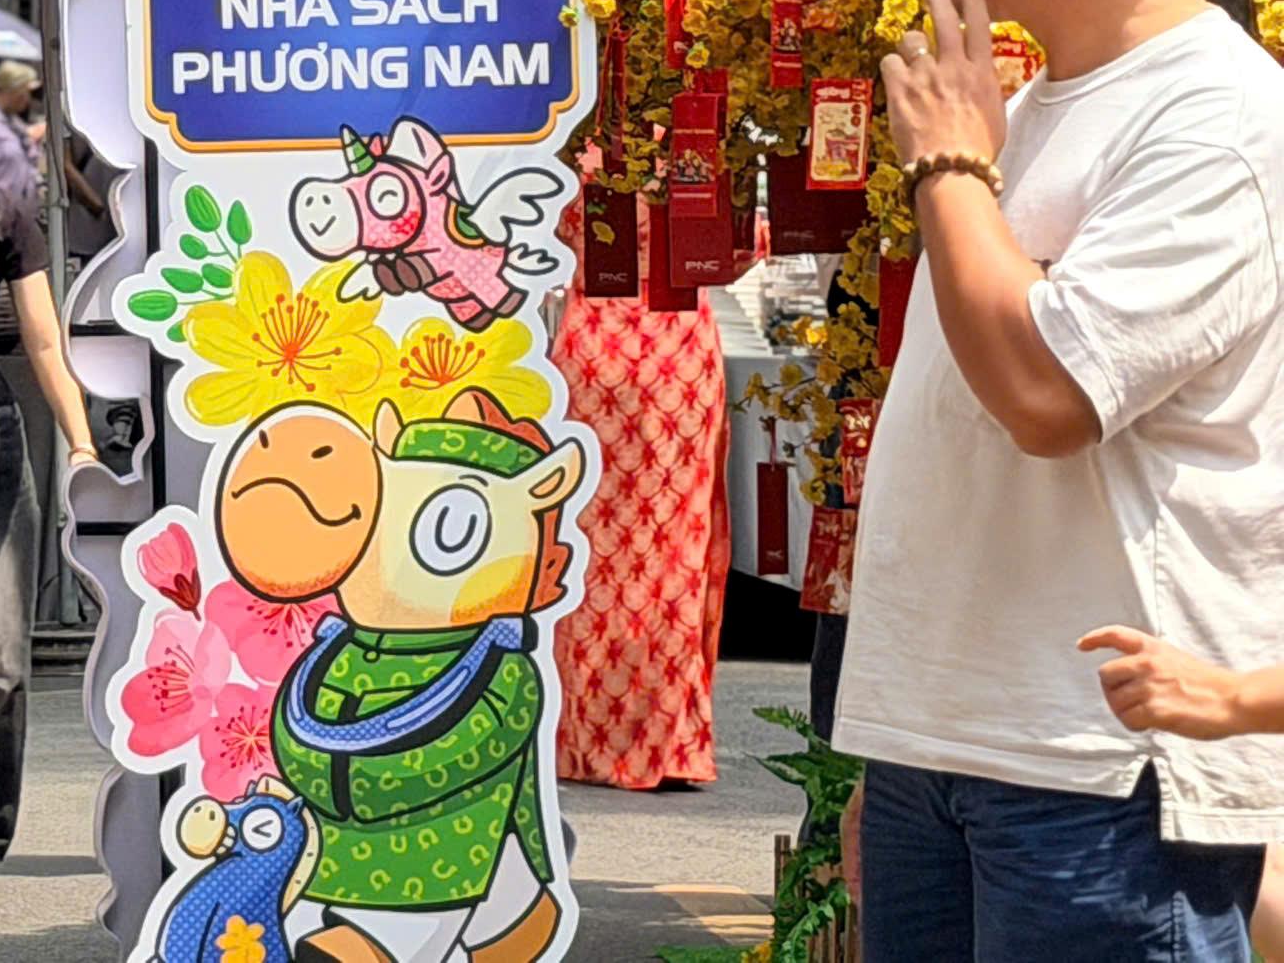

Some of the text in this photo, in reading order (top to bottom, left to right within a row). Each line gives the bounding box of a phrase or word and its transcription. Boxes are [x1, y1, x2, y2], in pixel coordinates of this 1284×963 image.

[172, 41, 550, 95] PHƯƠNG NAM
[684, 260, 720, 271] PNC
[598, 272, 628, 282] PNC
